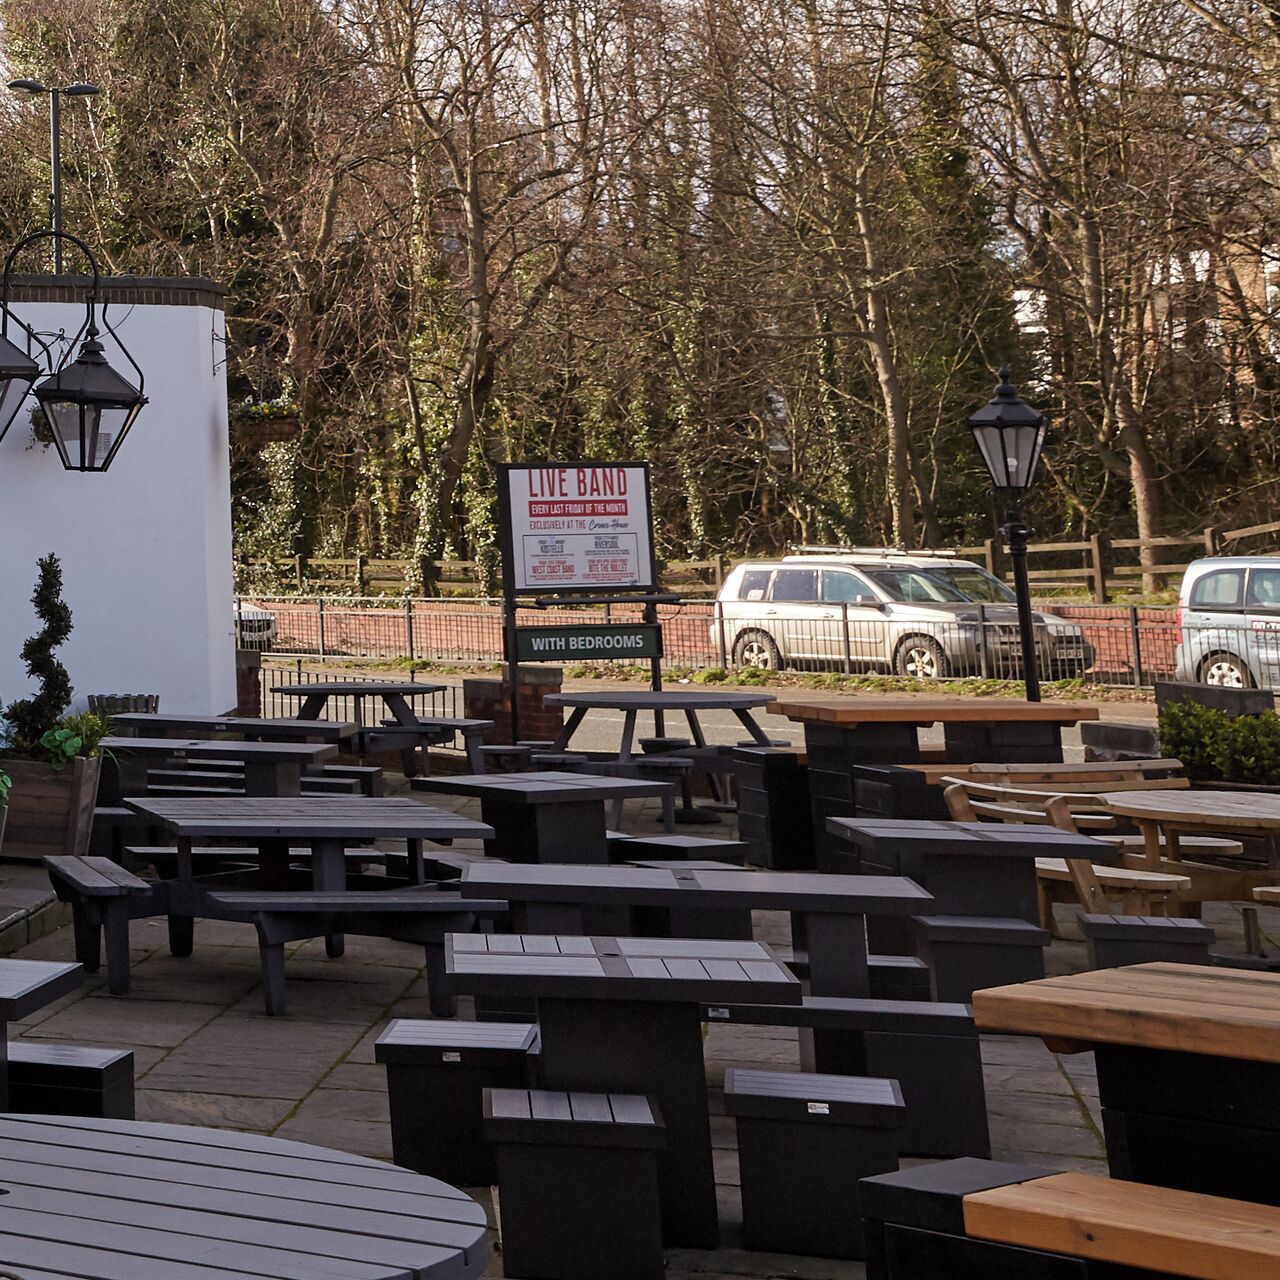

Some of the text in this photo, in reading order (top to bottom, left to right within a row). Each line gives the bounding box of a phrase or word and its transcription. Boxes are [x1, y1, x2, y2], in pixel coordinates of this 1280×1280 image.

[528, 468, 627, 498] LIVE BAND
[531, 502, 626, 515] EVERY LAST FRIDAY OF THE MONTH
[530, 520, 565, 530] EXCLUSIVELY
[567, 520, 574, 529] AT
[576, 519, 586, 529] THE
[532, 635, 644, 651] WITH BEDROOMS
